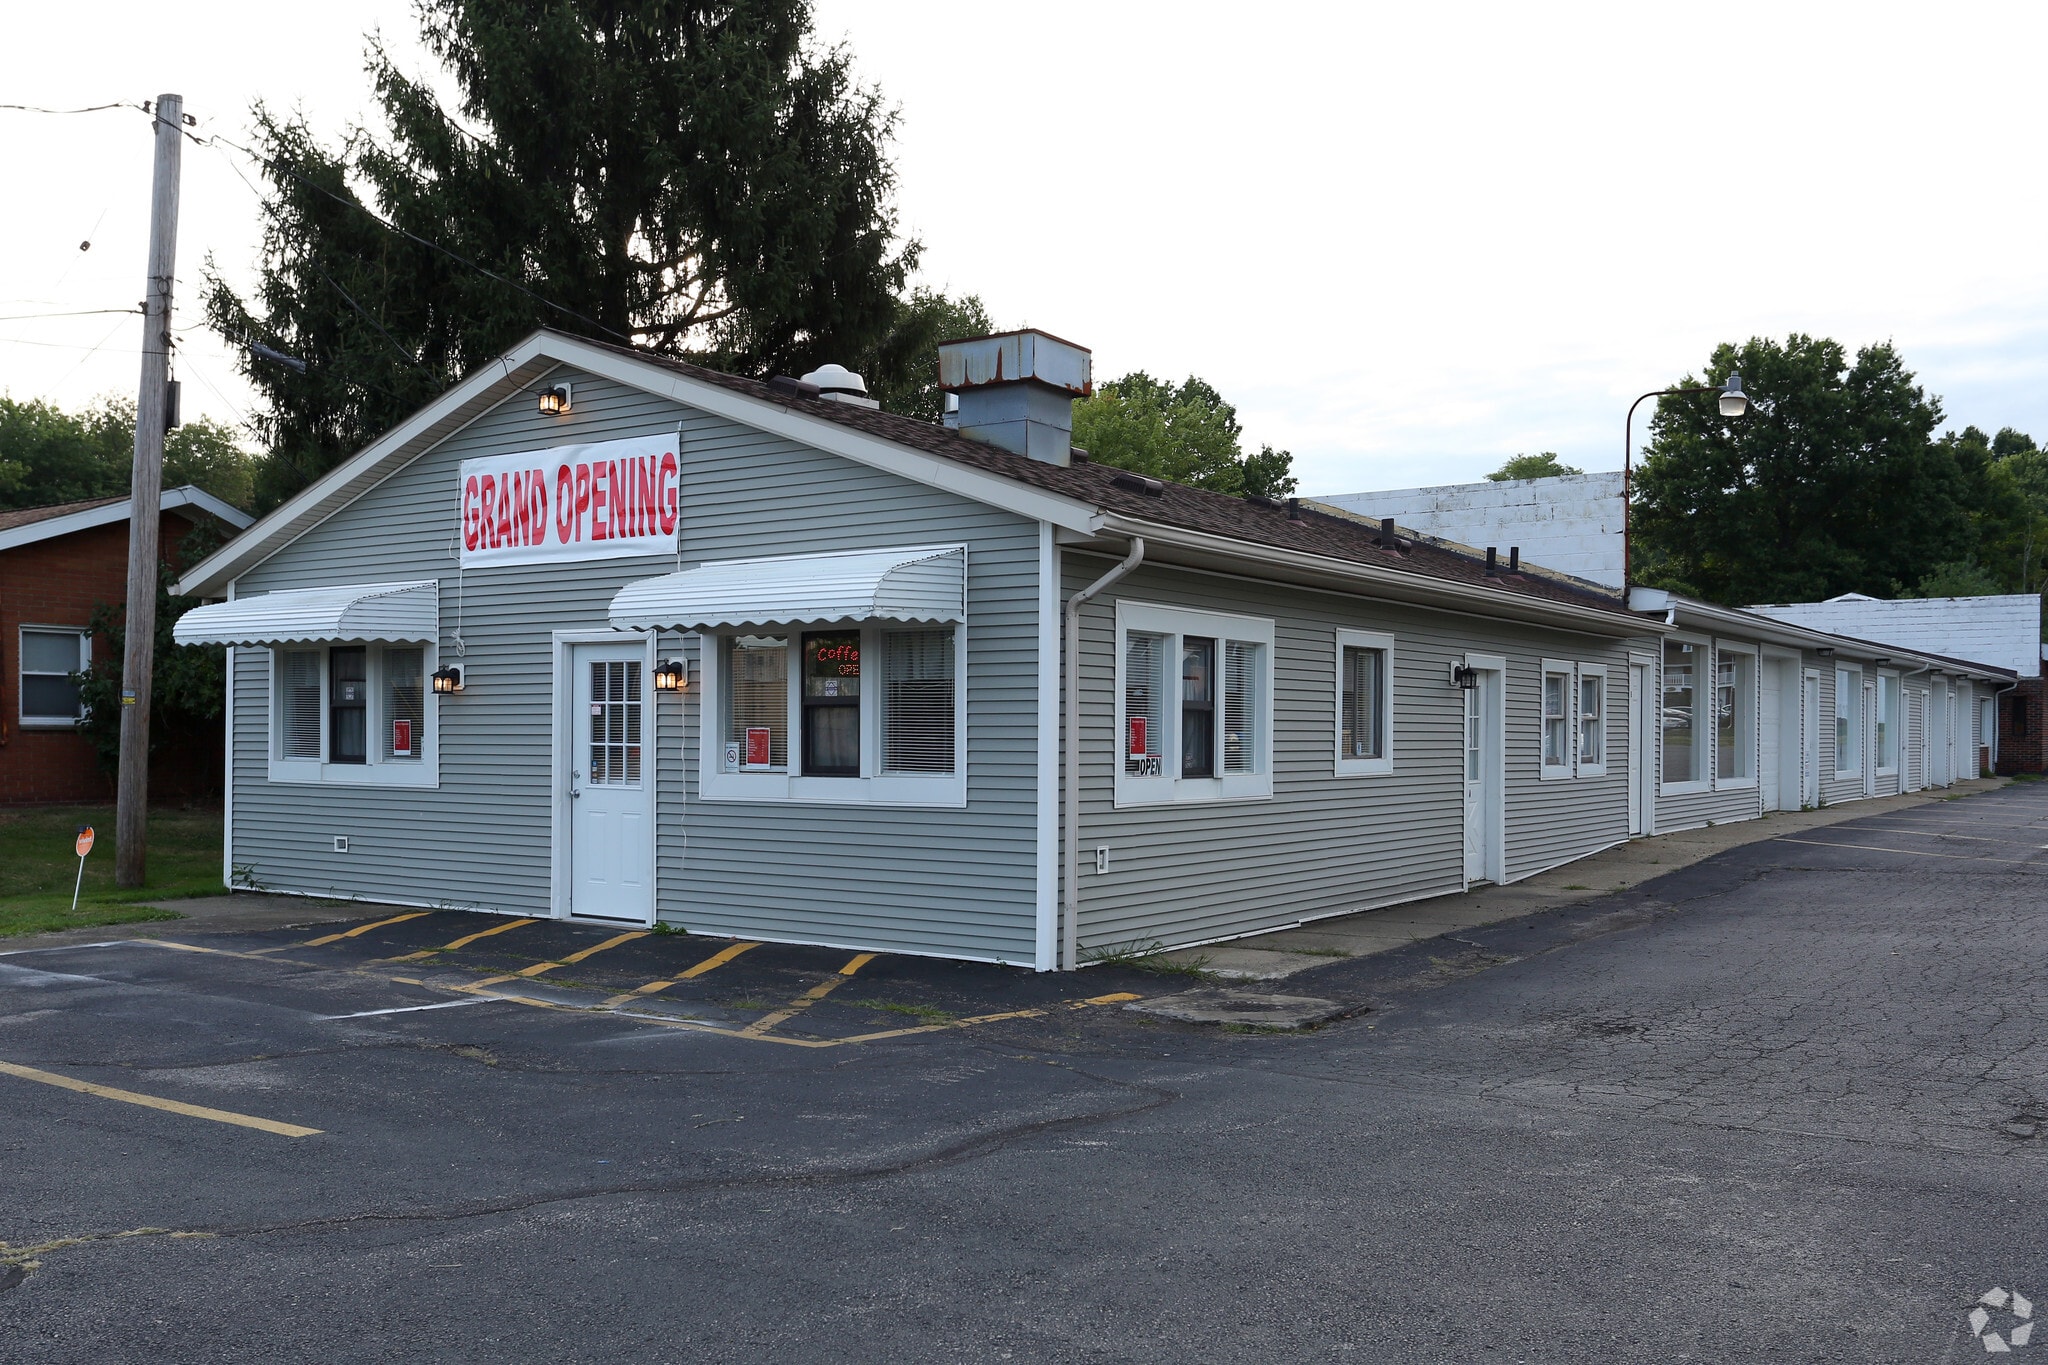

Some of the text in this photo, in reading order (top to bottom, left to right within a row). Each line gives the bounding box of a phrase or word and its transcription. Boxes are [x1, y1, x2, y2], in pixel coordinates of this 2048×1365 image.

[463, 452, 678, 551] GRAND OPENING
[1140, 757, 1162, 776] OPEN
